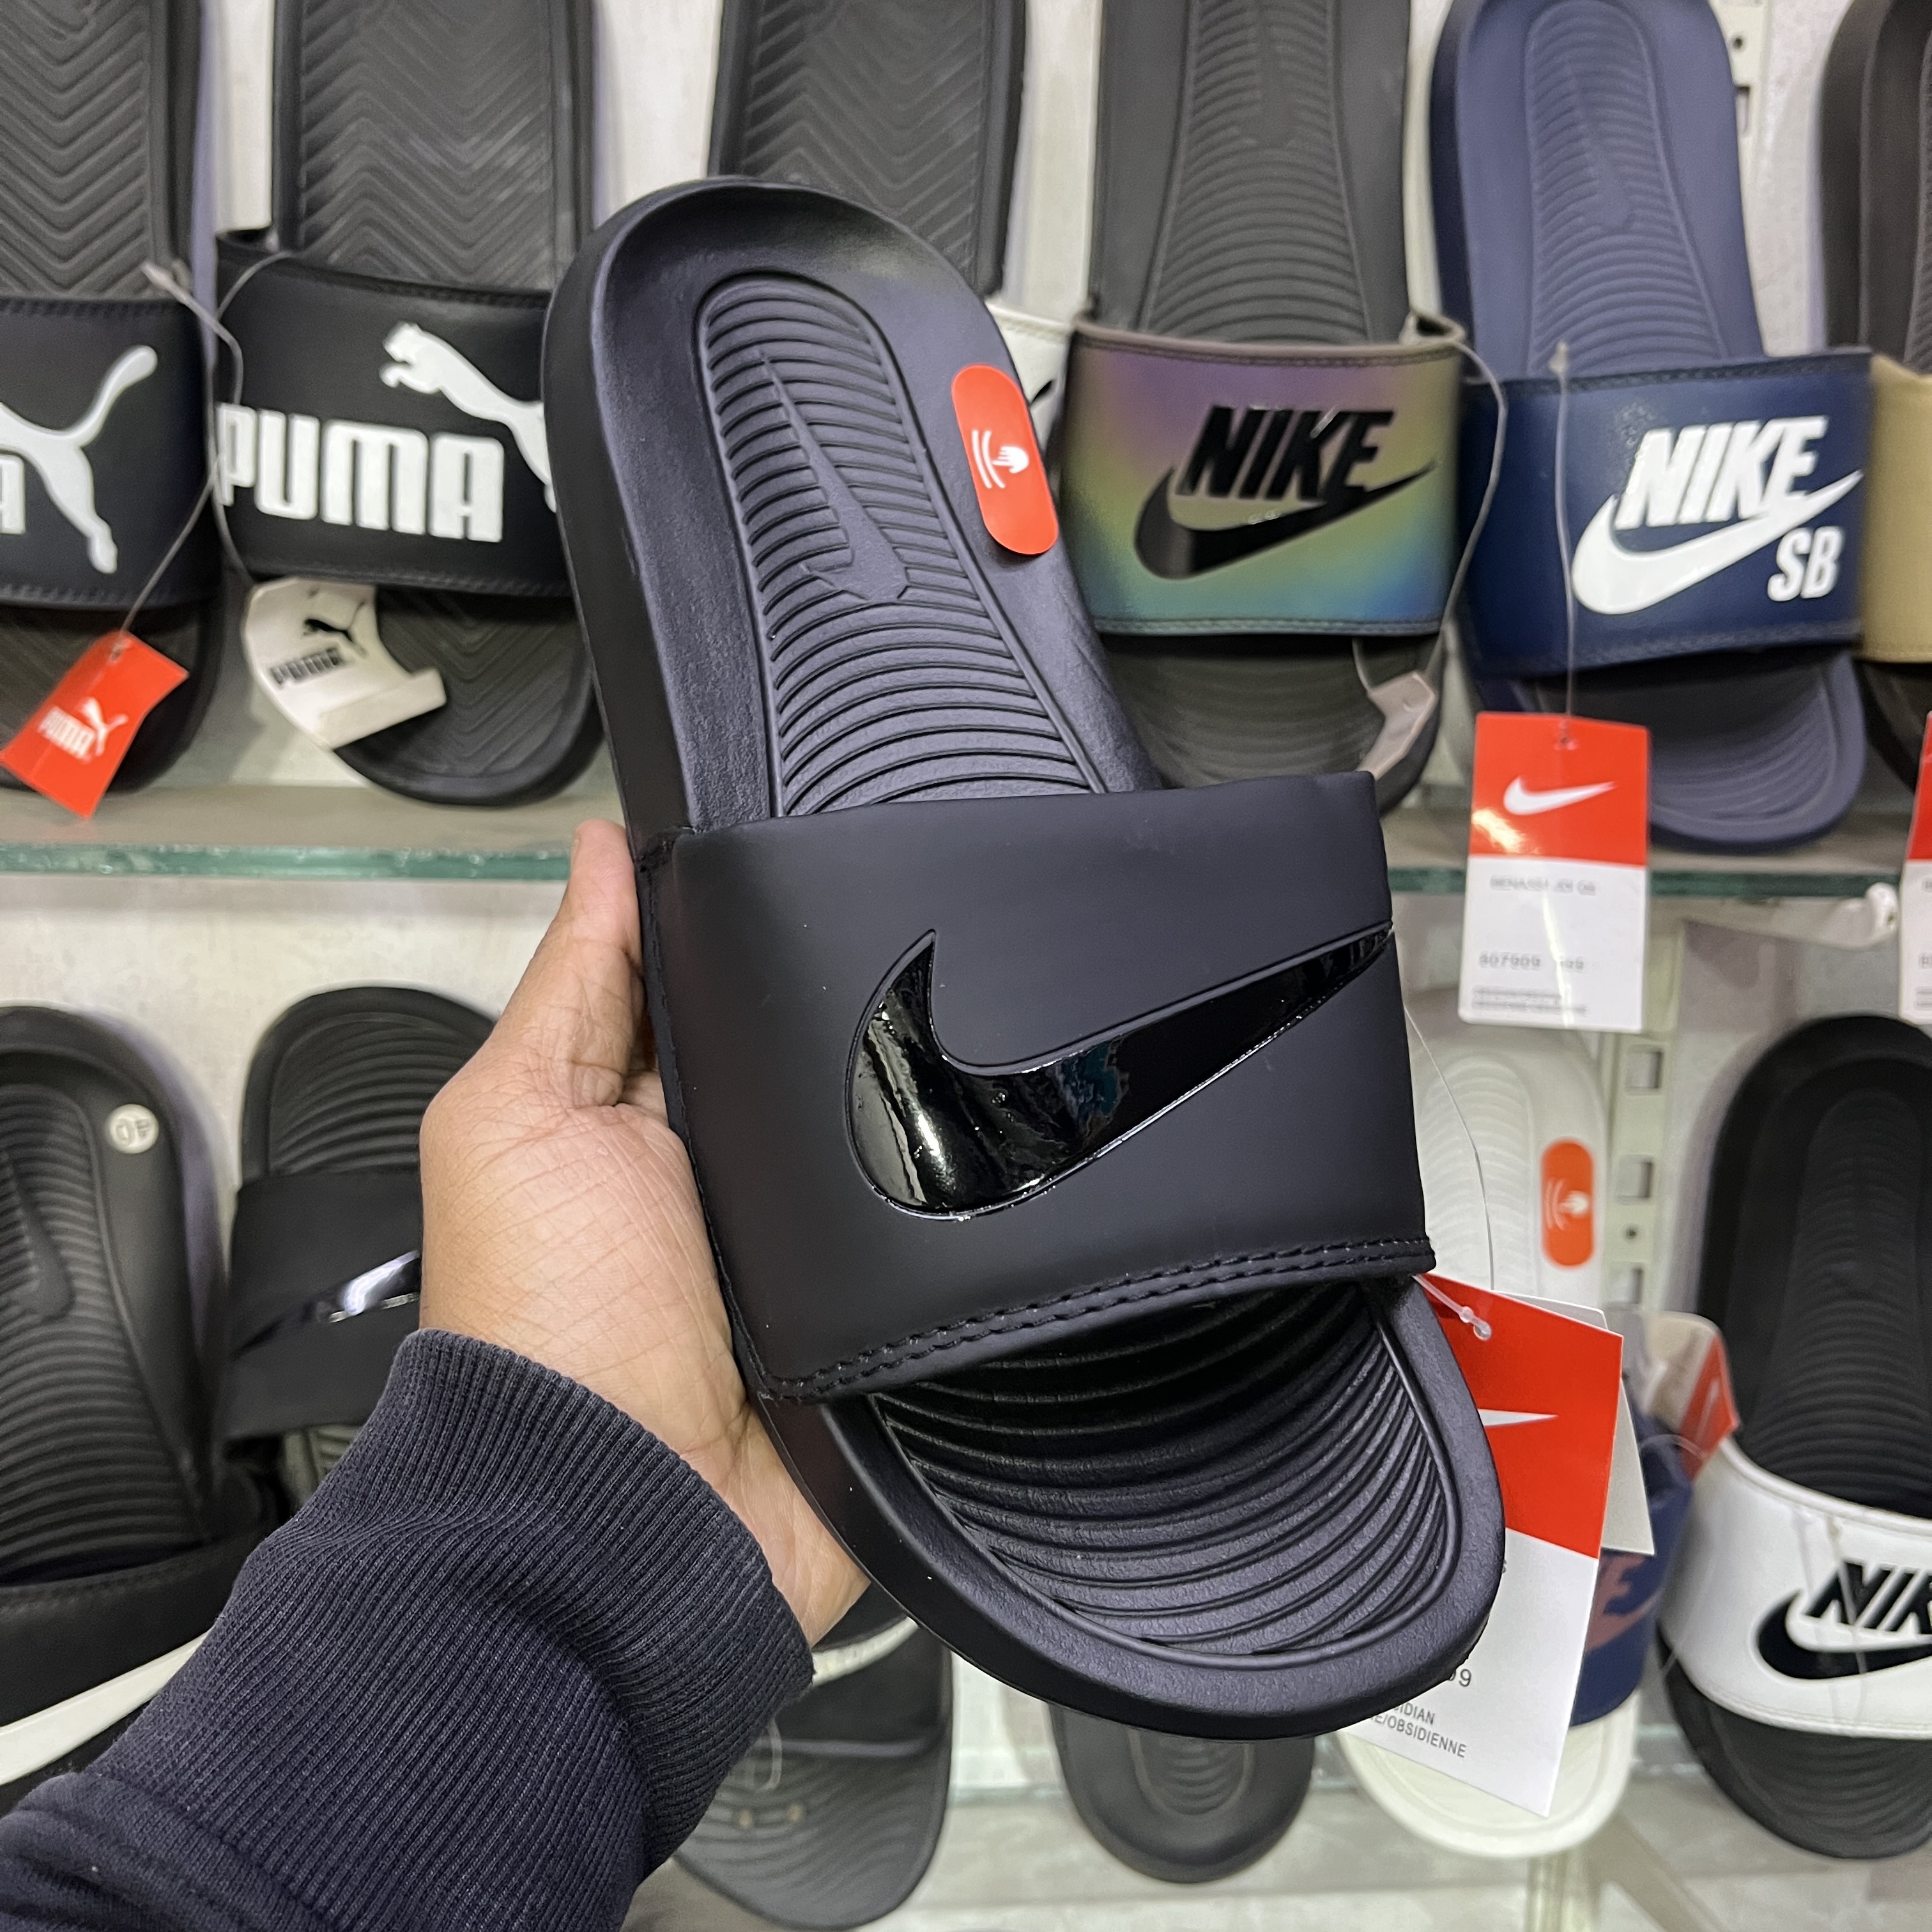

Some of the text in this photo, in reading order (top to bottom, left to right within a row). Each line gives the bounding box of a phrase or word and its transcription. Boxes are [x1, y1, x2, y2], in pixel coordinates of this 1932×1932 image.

[215, 402, 505, 543] PUMA
[1174, 404, 1395, 502] NIKE
[1614, 415, 1828, 530] NIKE
[1767, 526, 1844, 602] SB
[1370, 1713, 1468, 1758] E/OBSIDIENNE
[1393, 1702, 1436, 1725] IDIAN
